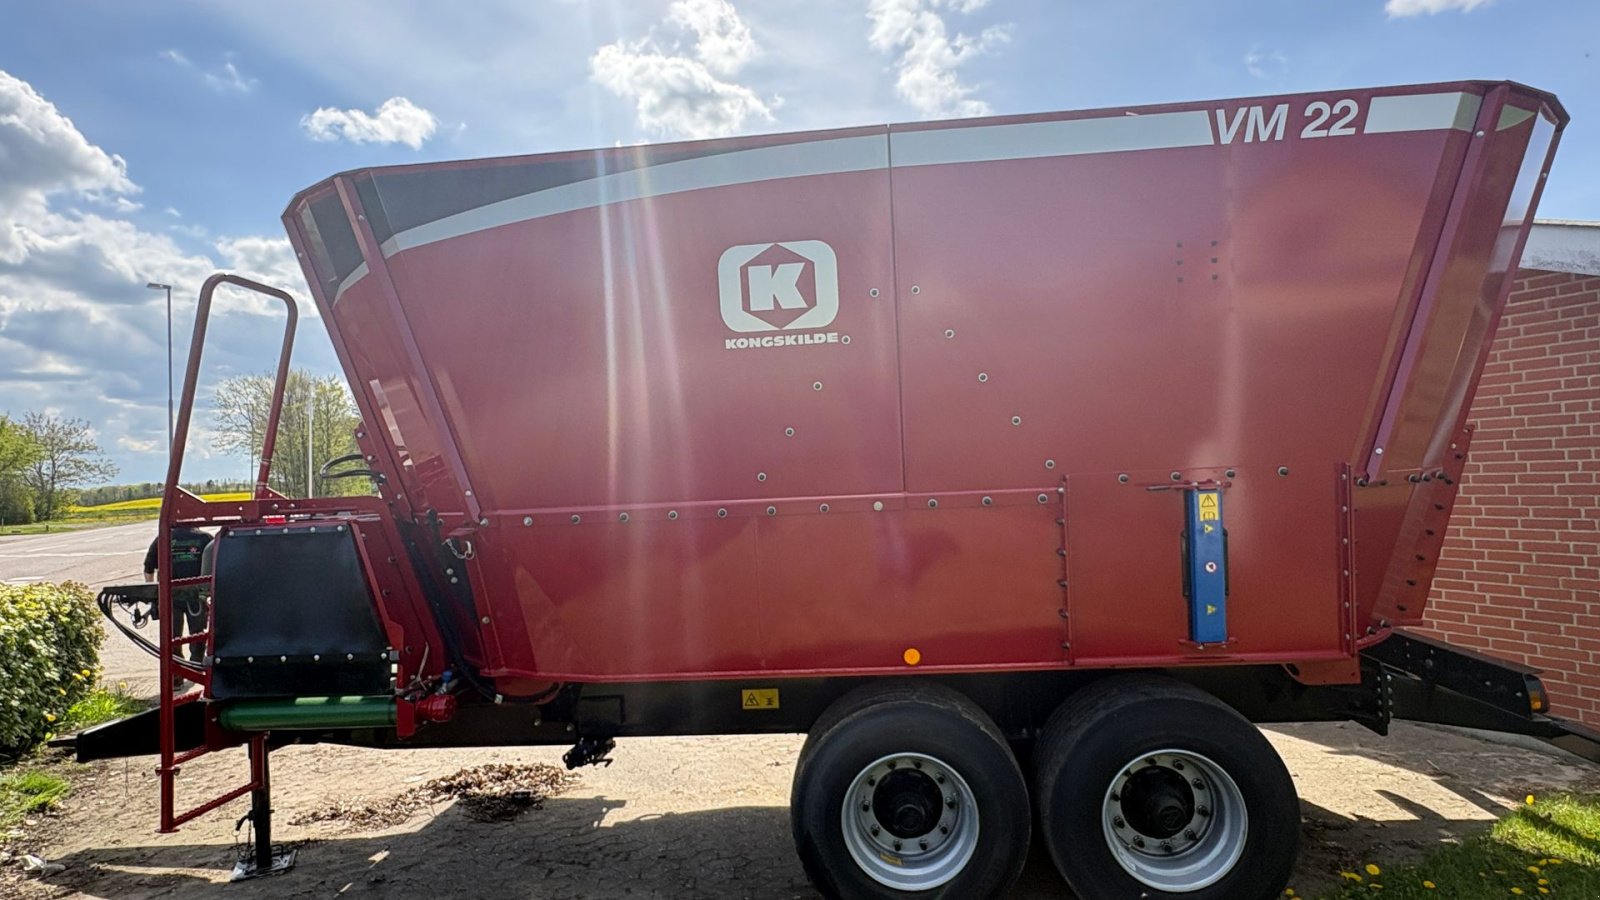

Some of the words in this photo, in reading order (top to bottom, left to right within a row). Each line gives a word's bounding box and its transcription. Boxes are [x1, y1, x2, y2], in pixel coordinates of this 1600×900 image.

[1215, 103, 1289, 145] VM
[1300, 99, 1358, 139] 22
[747, 262, 808, 312] K
[725, 332, 839, 349] KONGSKILDE
